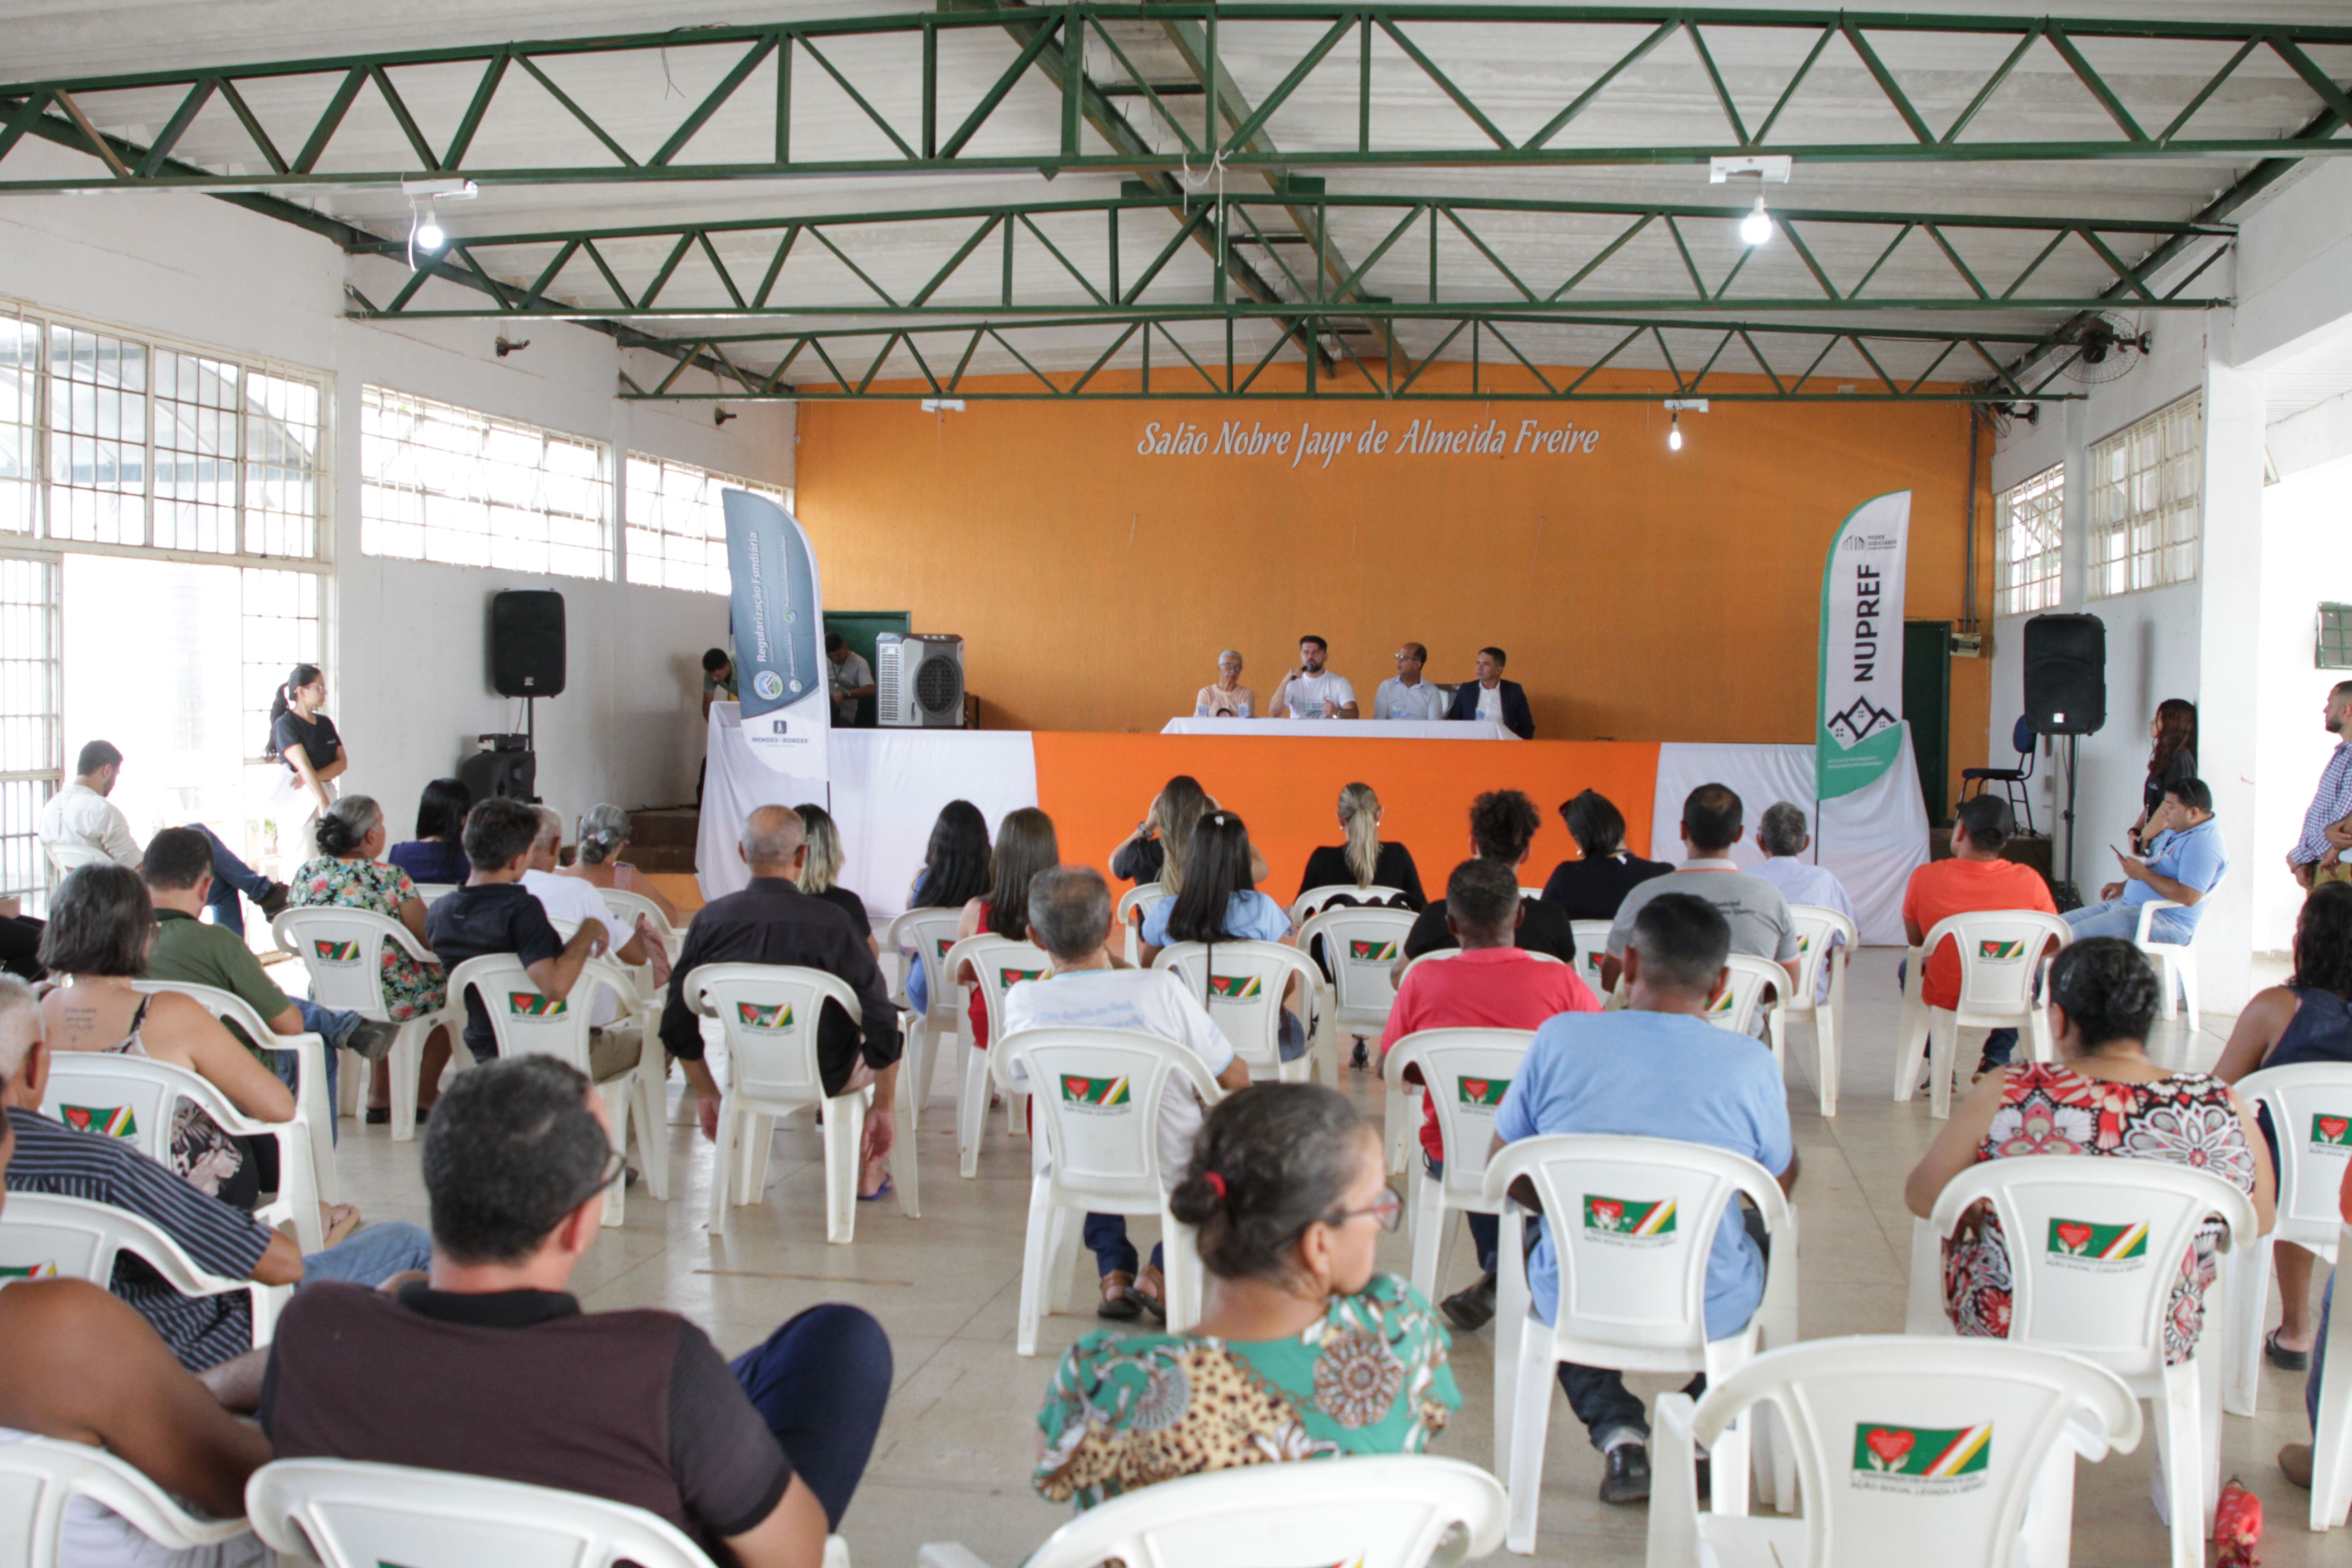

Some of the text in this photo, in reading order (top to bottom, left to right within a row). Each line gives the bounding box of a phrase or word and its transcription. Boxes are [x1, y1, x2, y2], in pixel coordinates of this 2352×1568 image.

[1137, 419, 1599, 469] Salão Nobre Jayr de Almeida Freire
[748, 531, 768, 662] Regularização Fundiária
[1854, 564, 1880, 682] NUPREF
